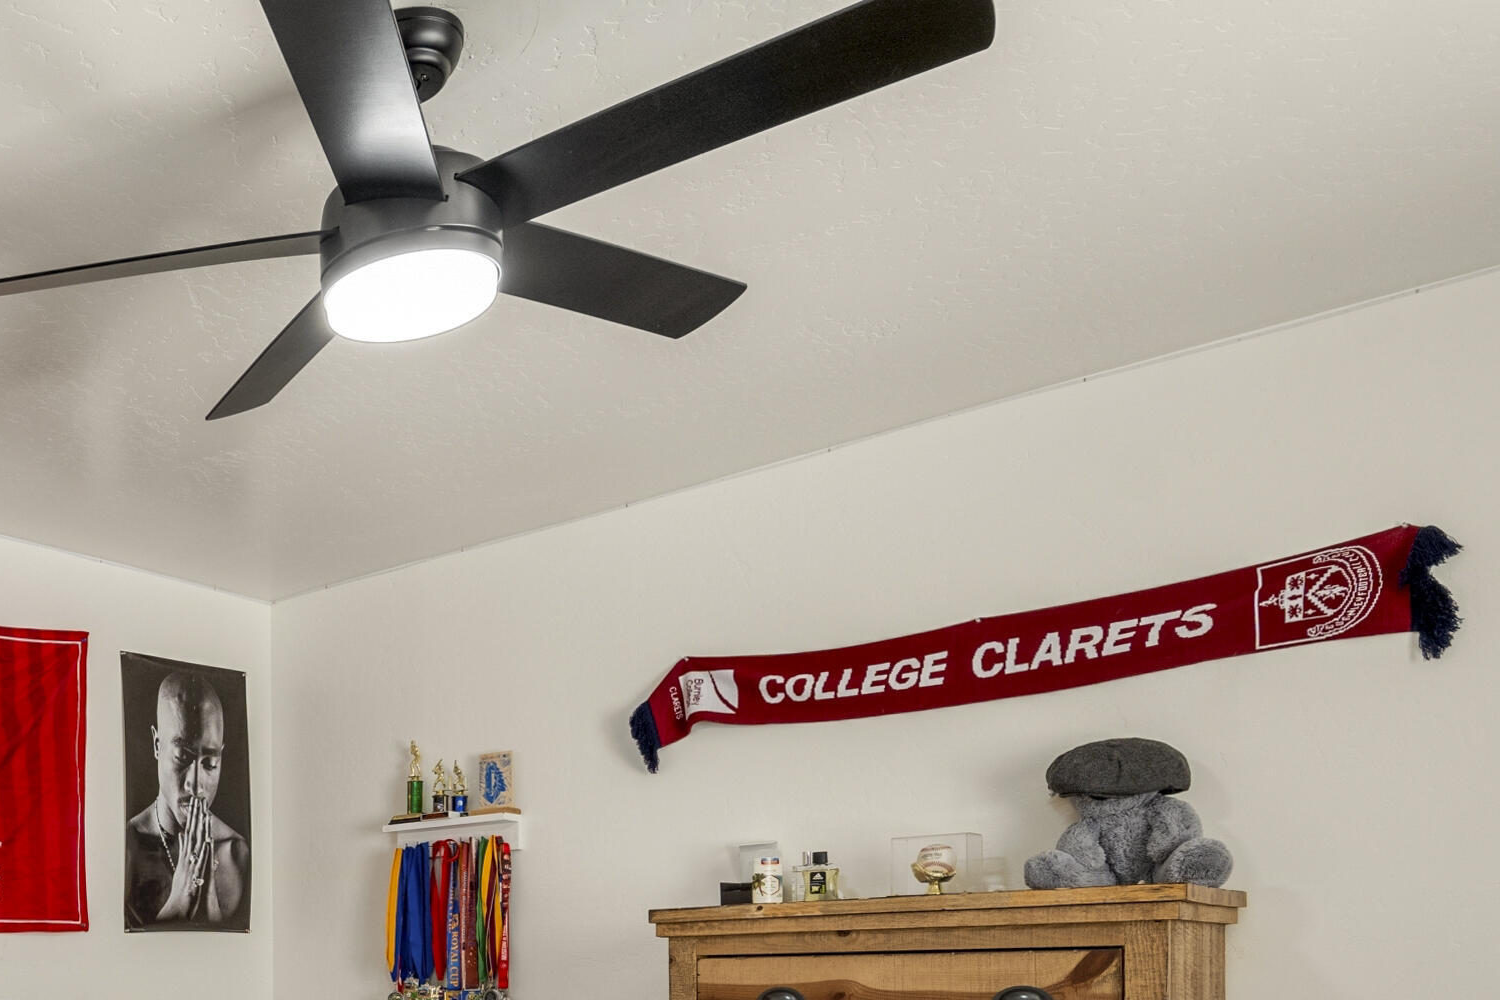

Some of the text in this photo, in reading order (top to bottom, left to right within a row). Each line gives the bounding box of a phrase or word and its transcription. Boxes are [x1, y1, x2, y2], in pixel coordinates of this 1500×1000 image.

[1351, 561, 1369, 596] FOOTBALL
[758, 603, 1218, 705] COLLEGE CLARETS
[669, 686, 684, 720] CLARETS
[691, 678, 704, 706] Burnley
[451, 931, 459, 965] ROYAL
[449, 966, 459, 987] CUP
